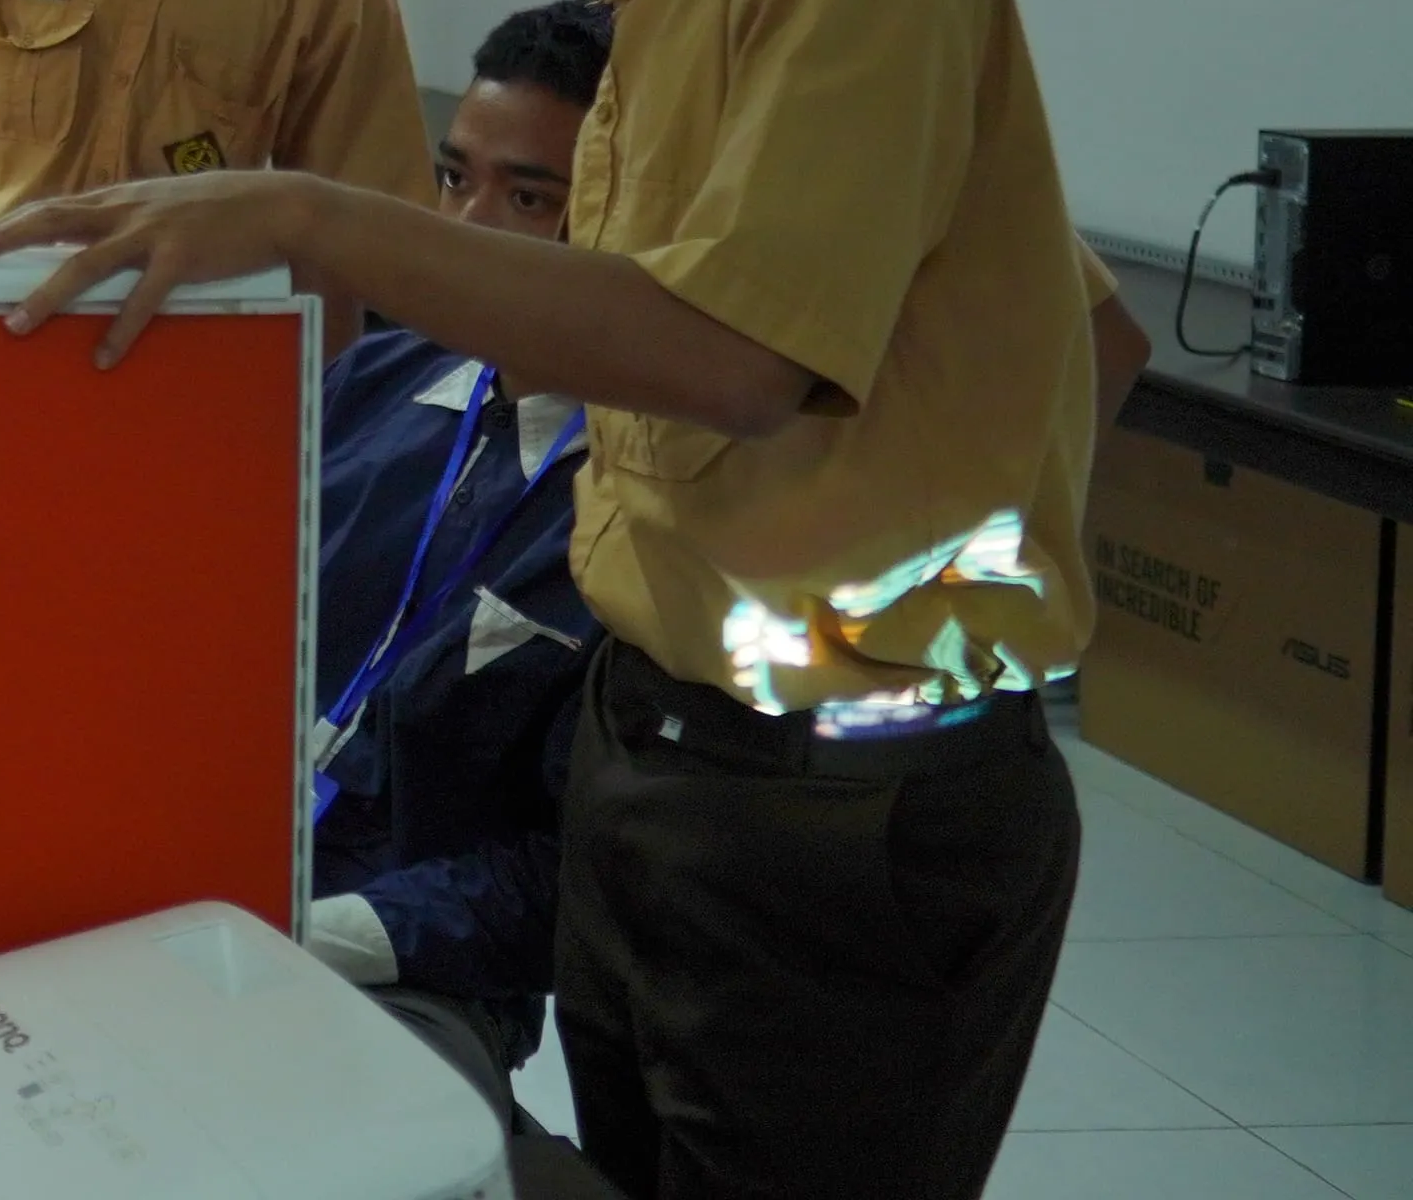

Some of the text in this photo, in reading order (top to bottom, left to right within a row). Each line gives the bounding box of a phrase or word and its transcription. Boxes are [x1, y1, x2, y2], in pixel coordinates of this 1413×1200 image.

[1095, 533, 1222, 611] IN SEARCH OF
[1095, 570, 1201, 643] INCREDIBLE
[1281, 637, 1351, 680] ASUS
